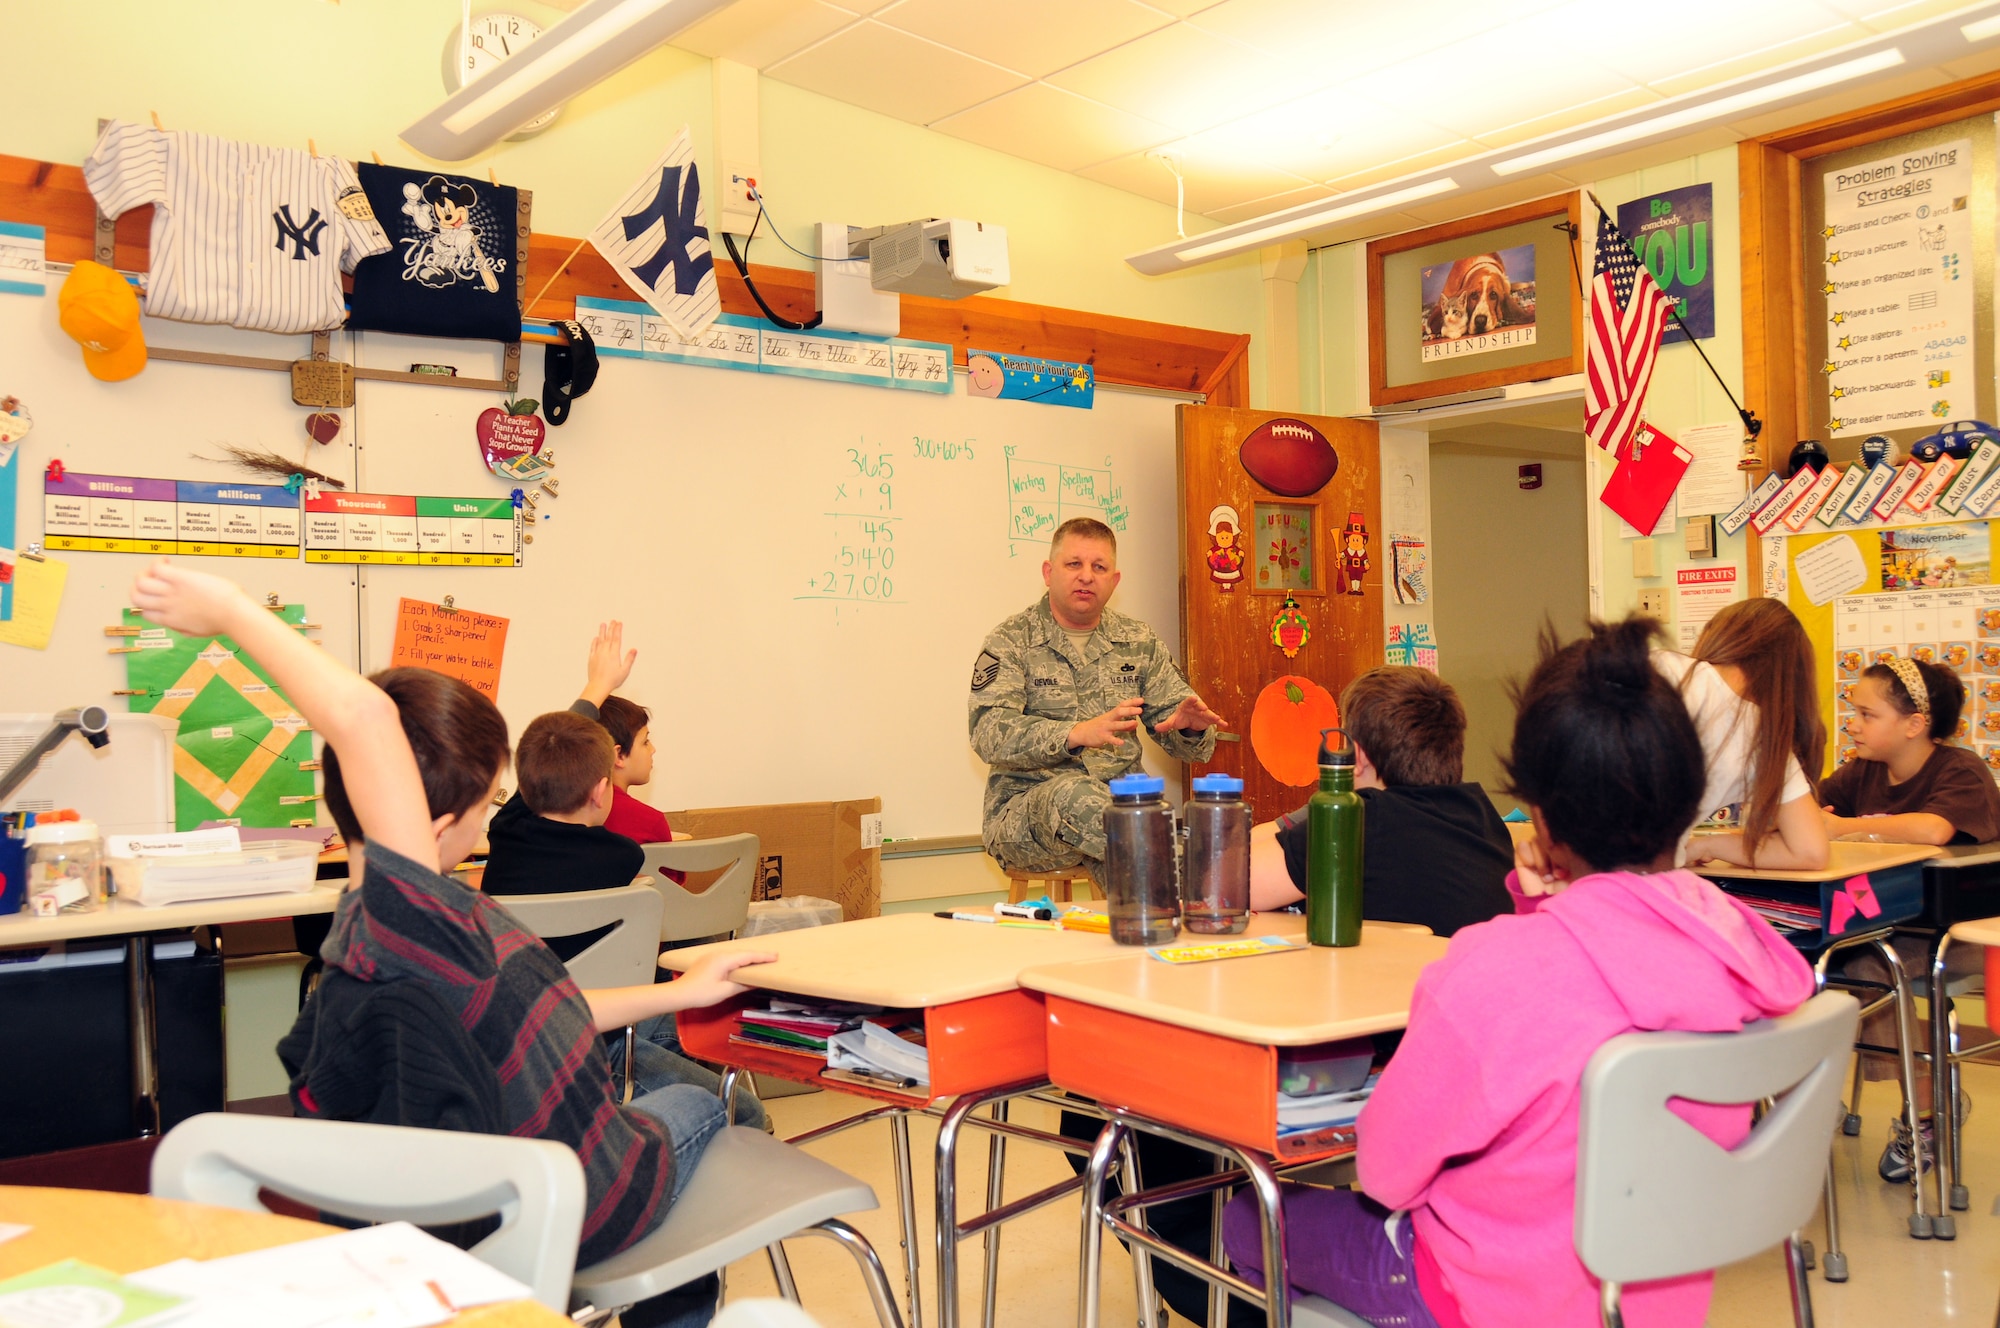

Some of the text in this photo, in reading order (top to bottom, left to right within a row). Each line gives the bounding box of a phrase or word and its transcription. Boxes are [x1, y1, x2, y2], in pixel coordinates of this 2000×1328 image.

[488, 21, 498, 37] 11
[507, 20, 519, 36] 12
[472, 33, 484, 49] 10
[467, 56, 475, 69] 9
[1835, 149, 1958, 190] Problem Solving
[1856, 178, 1933, 206] Strategies
[1650, 198, 1672, 219] Be
[1640, 213, 1681, 232] somebody
[1835, 206, 1949, 235] Guess and Check: and
[273, 203, 329, 261] NY
[1842, 239, 1908, 261] Draw a picture:
[399, 237, 507, 284] Yankees
[1835, 277, 1860, 291] Make
[1861, 274, 1872, 284] an
[1874, 268, 1916, 284] organized
[1844, 308, 1868, 320] Make
[1877, 303, 1901, 313] table:
[1423, 328, 1533, 359] FRIENDSHIP
[1852, 328, 1903, 346] Use algebra:
[1923, 335, 1967, 350] ABABAB
[614, 320, 634, 346] Pp
[707, 331, 727, 349] Ss
[766, 338, 790, 356] Uu
[799, 341, 821, 359] Vv
[865, 349, 887, 367] Xx
[898, 353, 919, 378] Yy
[925, 355, 943, 380] Zz
[1837, 358, 1859, 369] Look
[1861, 355, 1874, 365] for
[1876, 354, 1881, 362] a
[1883, 349, 1919, 362] pattern:
[1003, 358, 1032, 371] Reach
[1047, 364, 1066, 377] Your
[1067, 366, 1090, 380] Goals
[1845, 379, 1917, 396] Work backwards:
[495, 414, 530, 427] A Teacher
[1842, 408, 1926, 427] Use easier numbers:
[492, 421, 539, 437] Plants A Seed
[494, 430, 535, 445] That Never
[488, 437, 534, 454] Stops Growing
[845, 448, 894, 479] 365
[1012, 474, 1046, 494] Writing
[1062, 471, 1095, 491] Spelling
[1916, 463, 1950, 504] July (7)
[1949, 447, 1992, 506] August (8)
[89, 481, 134, 494] Billions
[217, 489, 262, 501] Millions
[1076, 484, 1095, 500] City
[1825, 473, 1858, 518] April (4)
[1853, 472, 1885, 514] May (5)
[1882, 468, 1917, 511] June (6)
[335, 498, 387, 510] Thousands
[453, 503, 478, 513] Units
[1730, 479, 1778, 529] January (1)
[1758, 475, 1810, 525] February (2)
[1792, 475, 1833, 523] March (3)
[1021, 505, 1034, 518] 90
[864, 520, 894, 543] 45
[1022, 512, 1056, 537] Spelling
[1910, 531, 1967, 545] November
[841, 545, 894, 570] 540
[1679, 569, 1735, 582] FIRE EXITS
[1764, 559, 1778, 590] Friday
[1842, 590, 1974, 606] Sunday Monday Tuesday Wednesday
[402, 600, 503, 631] Each Morning please:
[412, 619, 434, 634] Grab
[435, 623, 442, 634] 3
[444, 625, 488, 642] sharpened
[415, 633, 448, 646] pencils.
[410, 648, 423, 660] Fill
[425, 652, 443, 664] your
[446, 653, 468, 665] water
[471, 655, 498, 670] bottle.
[1850, 656, 1856, 668] 4
[1990, 654, 1997, 664] 8
[476, 679, 495, 691] and
